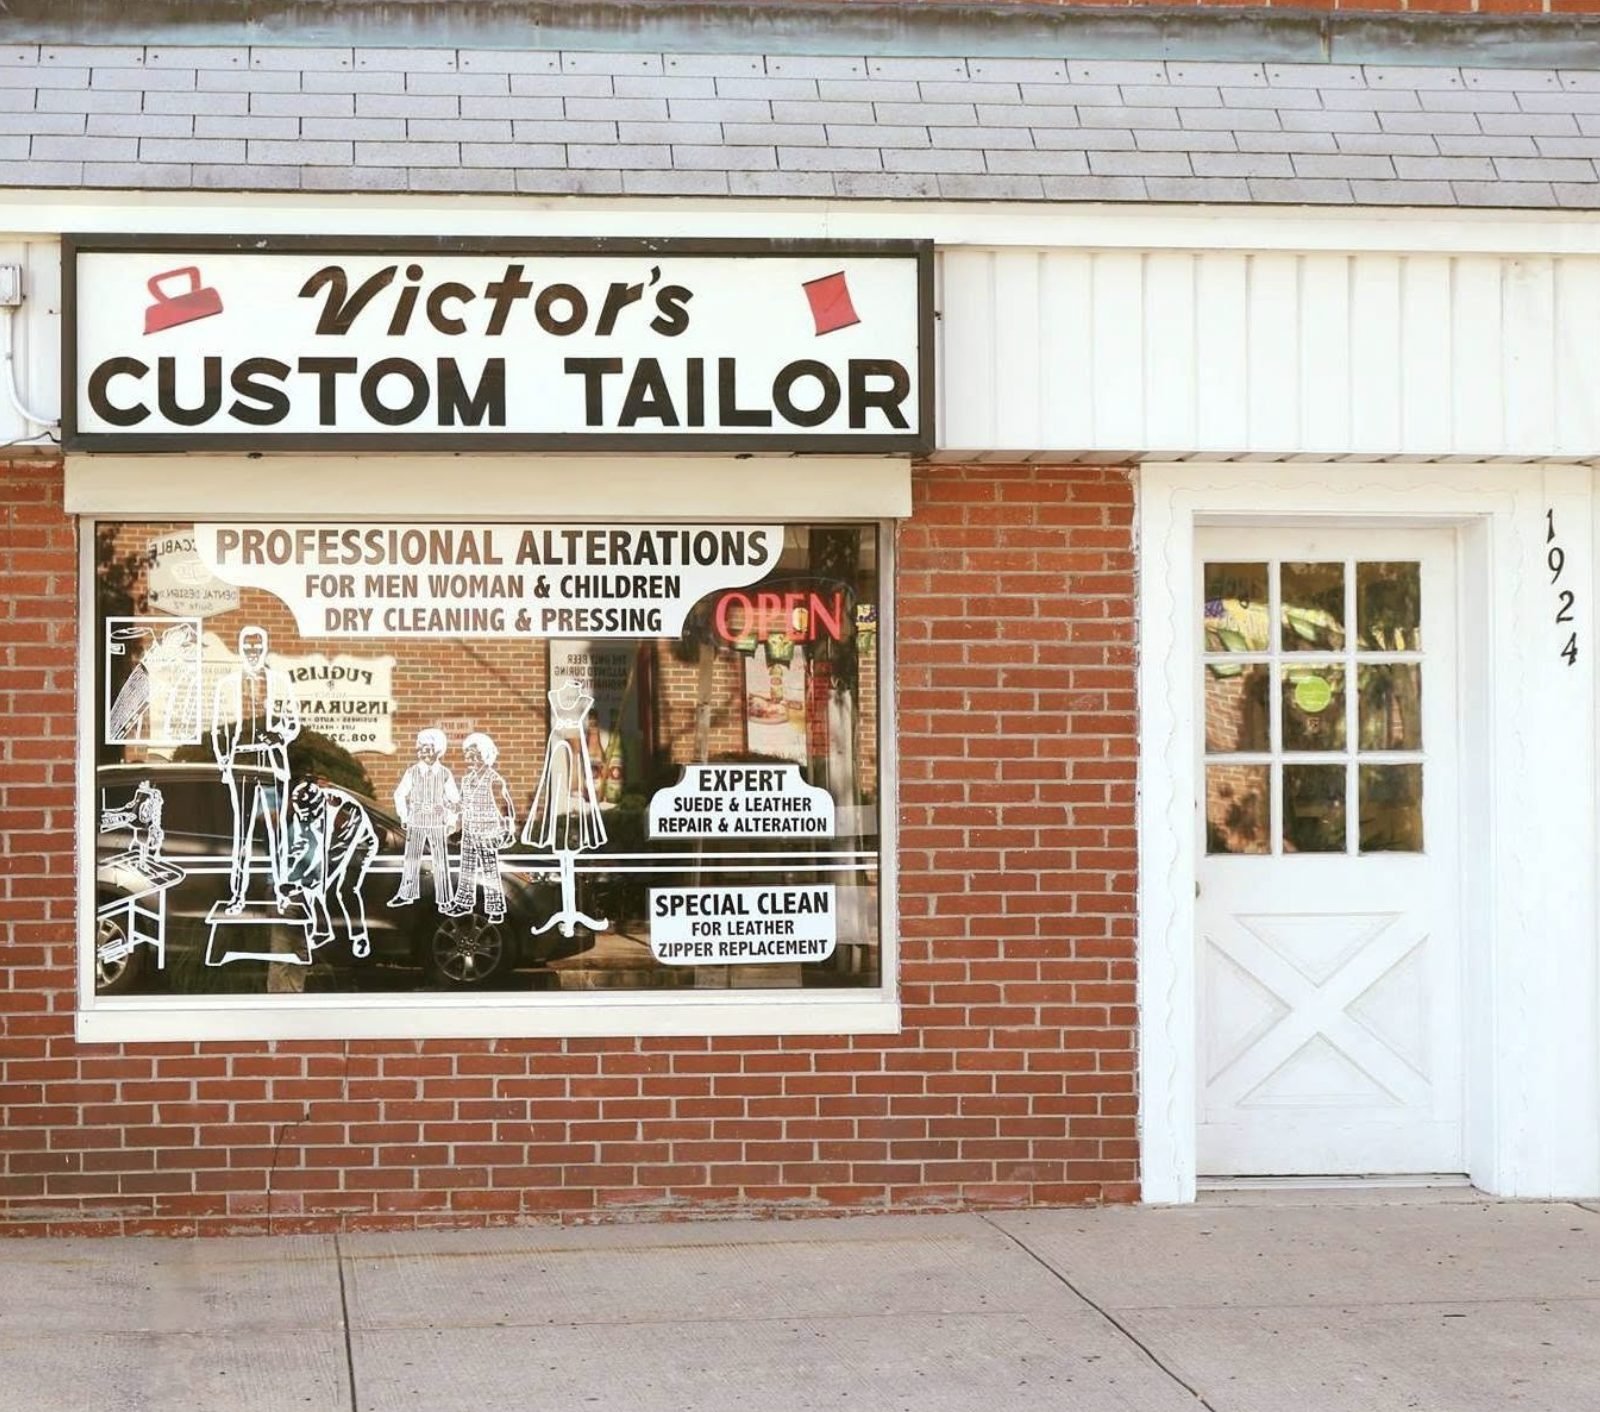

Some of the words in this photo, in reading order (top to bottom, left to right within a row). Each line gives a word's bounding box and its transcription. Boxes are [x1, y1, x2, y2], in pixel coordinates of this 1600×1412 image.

[299, 264, 693, 337] Victor's
[88, 357, 506, 427] CUSTOM
[564, 357, 910, 429] TAILOR
[216, 529, 502, 566] PROFESSIONAL
[515, 529, 769, 567] ALTERATIONS
[305, 574, 356, 599] FOR
[364, 574, 418, 599] MEN
[428, 574, 524, 599] WOMAN
[533, 574, 551, 599] &
[559, 574, 681, 600] CHILDREN
[1547, 508, 1578, 666] 1924
[325, 607, 374, 632] DRY
[383, 607, 505, 632] CLEANING
[514, 607, 532, 632] &
[541, 607, 662, 632] PRESSING
[715, 591, 842, 643] OPEN
[699, 769, 787, 792] EXPERT
[673, 797, 723, 812] SUEDE
[728, 797, 740, 812] &
[745, 797, 812, 812] LEATHER
[658, 817, 713, 833] REPAIR
[717, 817, 729, 833] &
[734, 817, 827, 833] ALTERATION
[655, 893, 749, 917] SPECIAL
[757, 891, 829, 915] CLEAN
[691, 921, 722, 936] FOR
[727, 919, 795, 936] LEATHER
[658, 942, 714, 958] ZIPPER
[719, 939, 828, 957] REPLACEMENT
